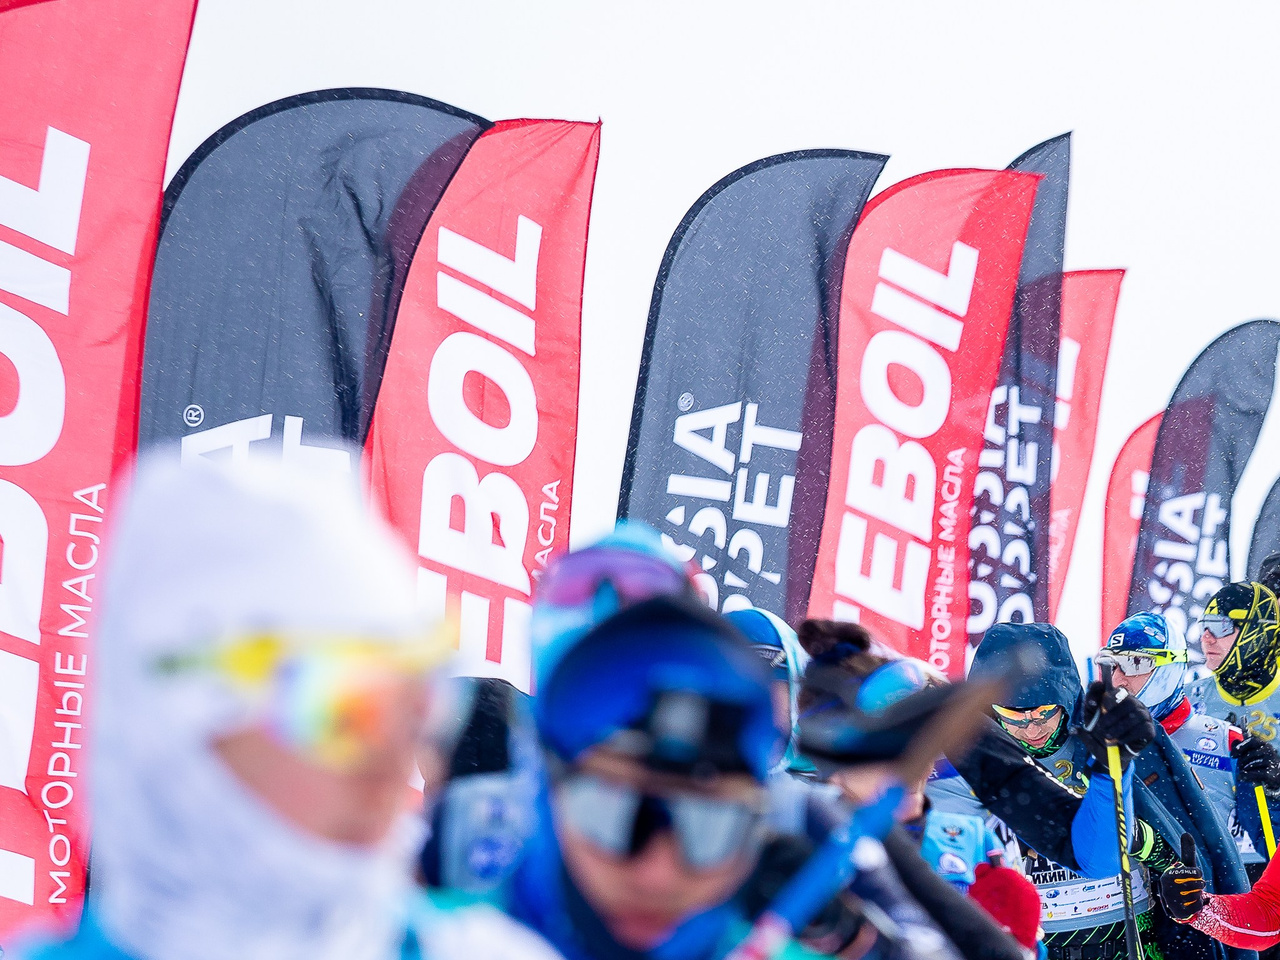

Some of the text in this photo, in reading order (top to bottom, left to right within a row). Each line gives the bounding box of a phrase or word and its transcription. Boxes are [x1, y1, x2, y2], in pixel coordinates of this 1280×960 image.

[417, 214, 543, 697] EBOIL
[833, 240, 979, 631] EBOIL
[928, 447, 967, 676] ОТОРНЫЕ МАСЛА
[42, 482, 107, 905] МОТОРНЫЕ МАСЛА
